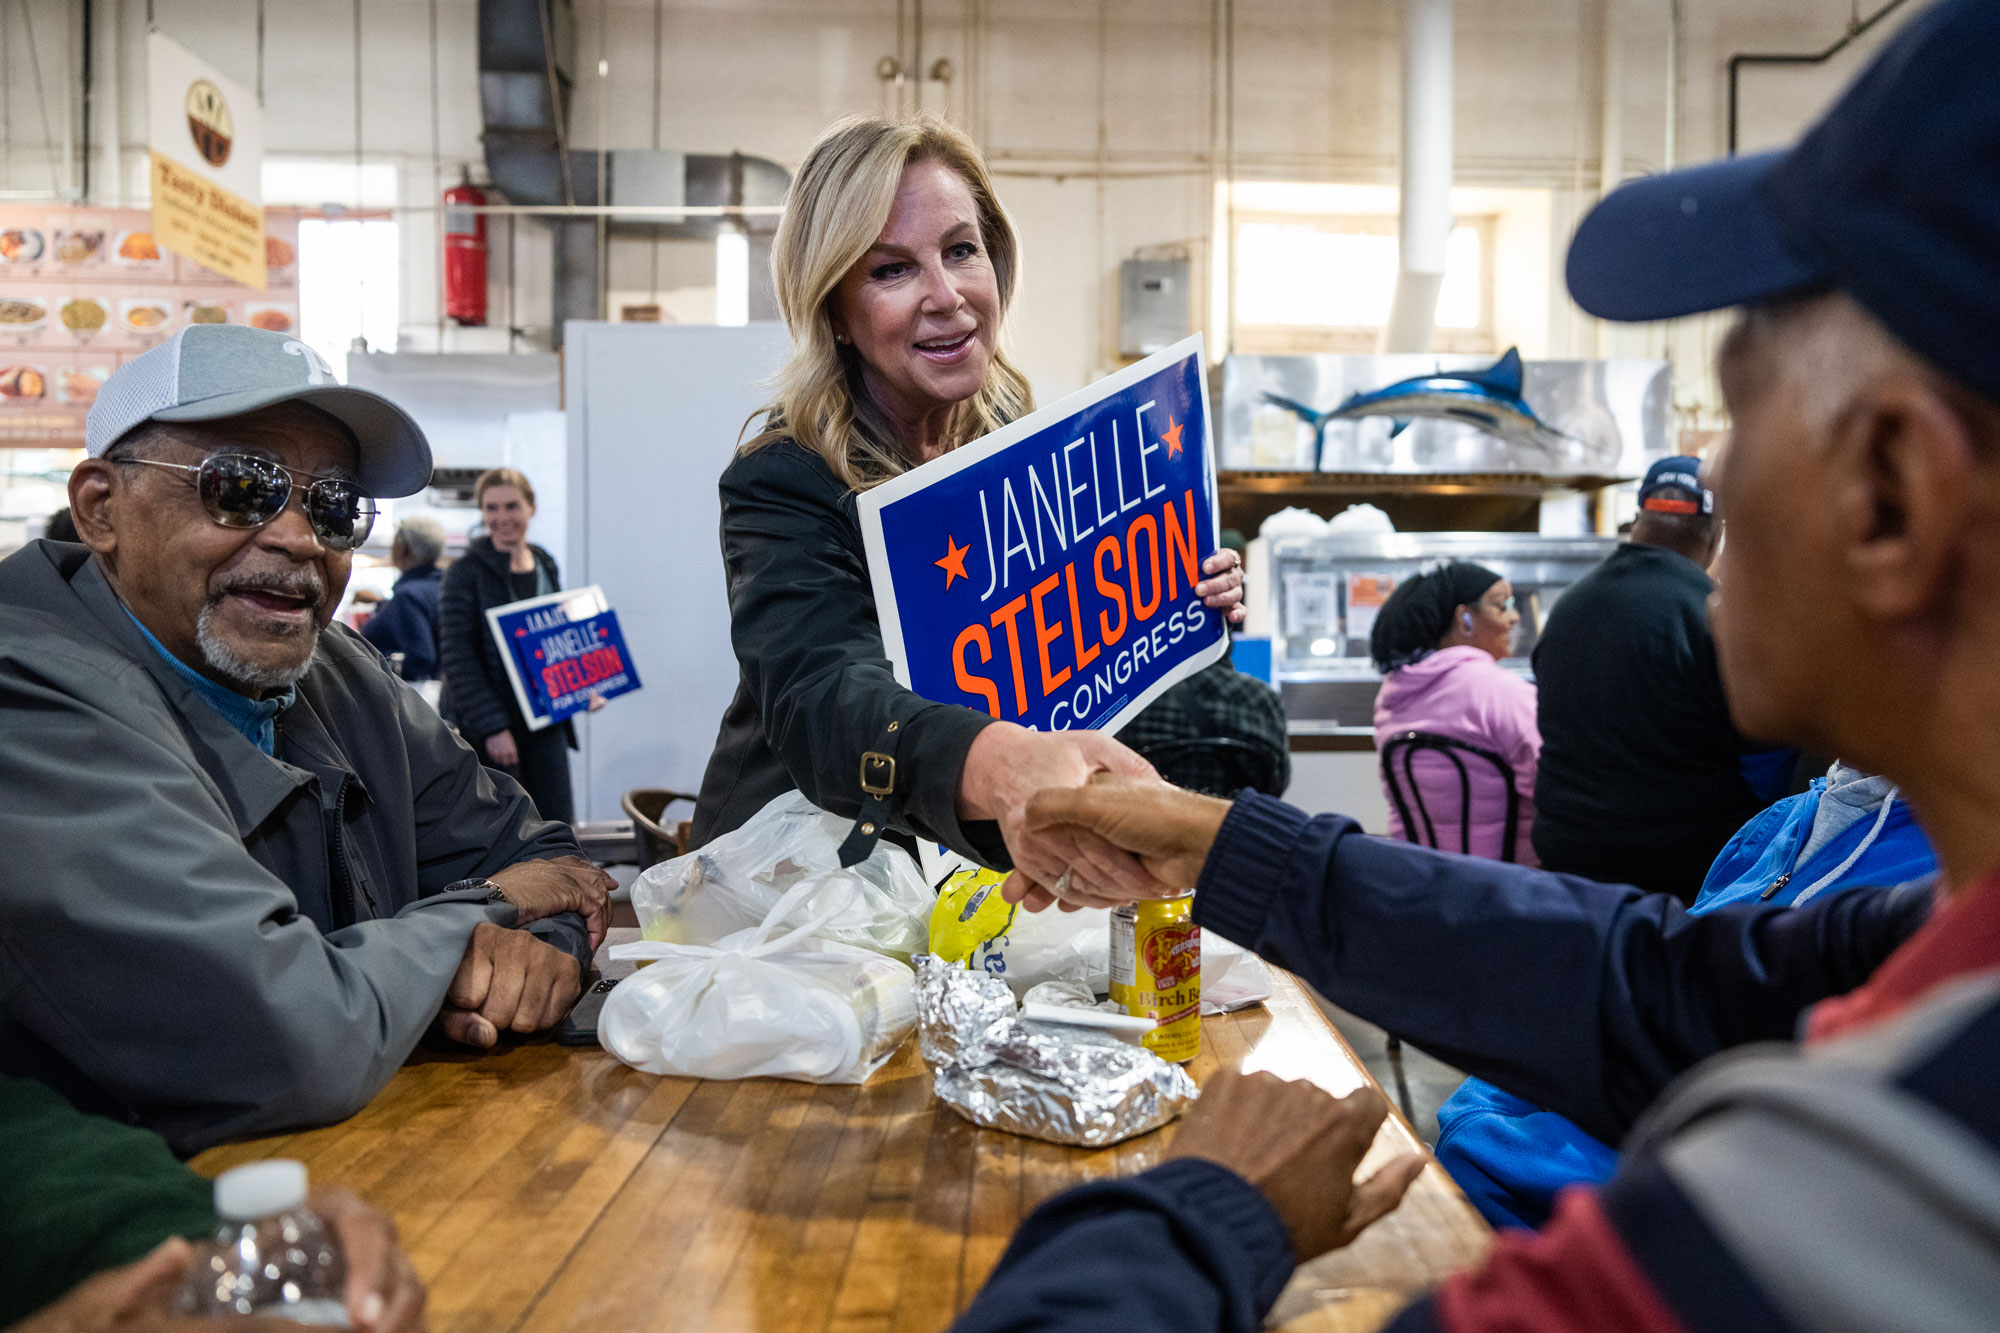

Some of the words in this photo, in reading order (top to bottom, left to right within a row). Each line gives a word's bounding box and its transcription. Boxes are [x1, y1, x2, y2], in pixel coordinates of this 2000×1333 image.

[159, 162, 204, 206] Tasty
[979, 399, 1166, 602] JANELLE
[1656, 471, 1677, 485] NEW
[1677, 472, 1698, 489] YORK
[951, 488, 1199, 721] STELSON
[541, 620, 605, 666] JANELLE
[1049, 600, 1206, 732] CONGRESS
[541, 644, 624, 699] STELSON
[551, 692, 574, 711] FOR
[573, 672, 629, 703] CONGRESS
[1138, 989, 1185, 1007] Birch
